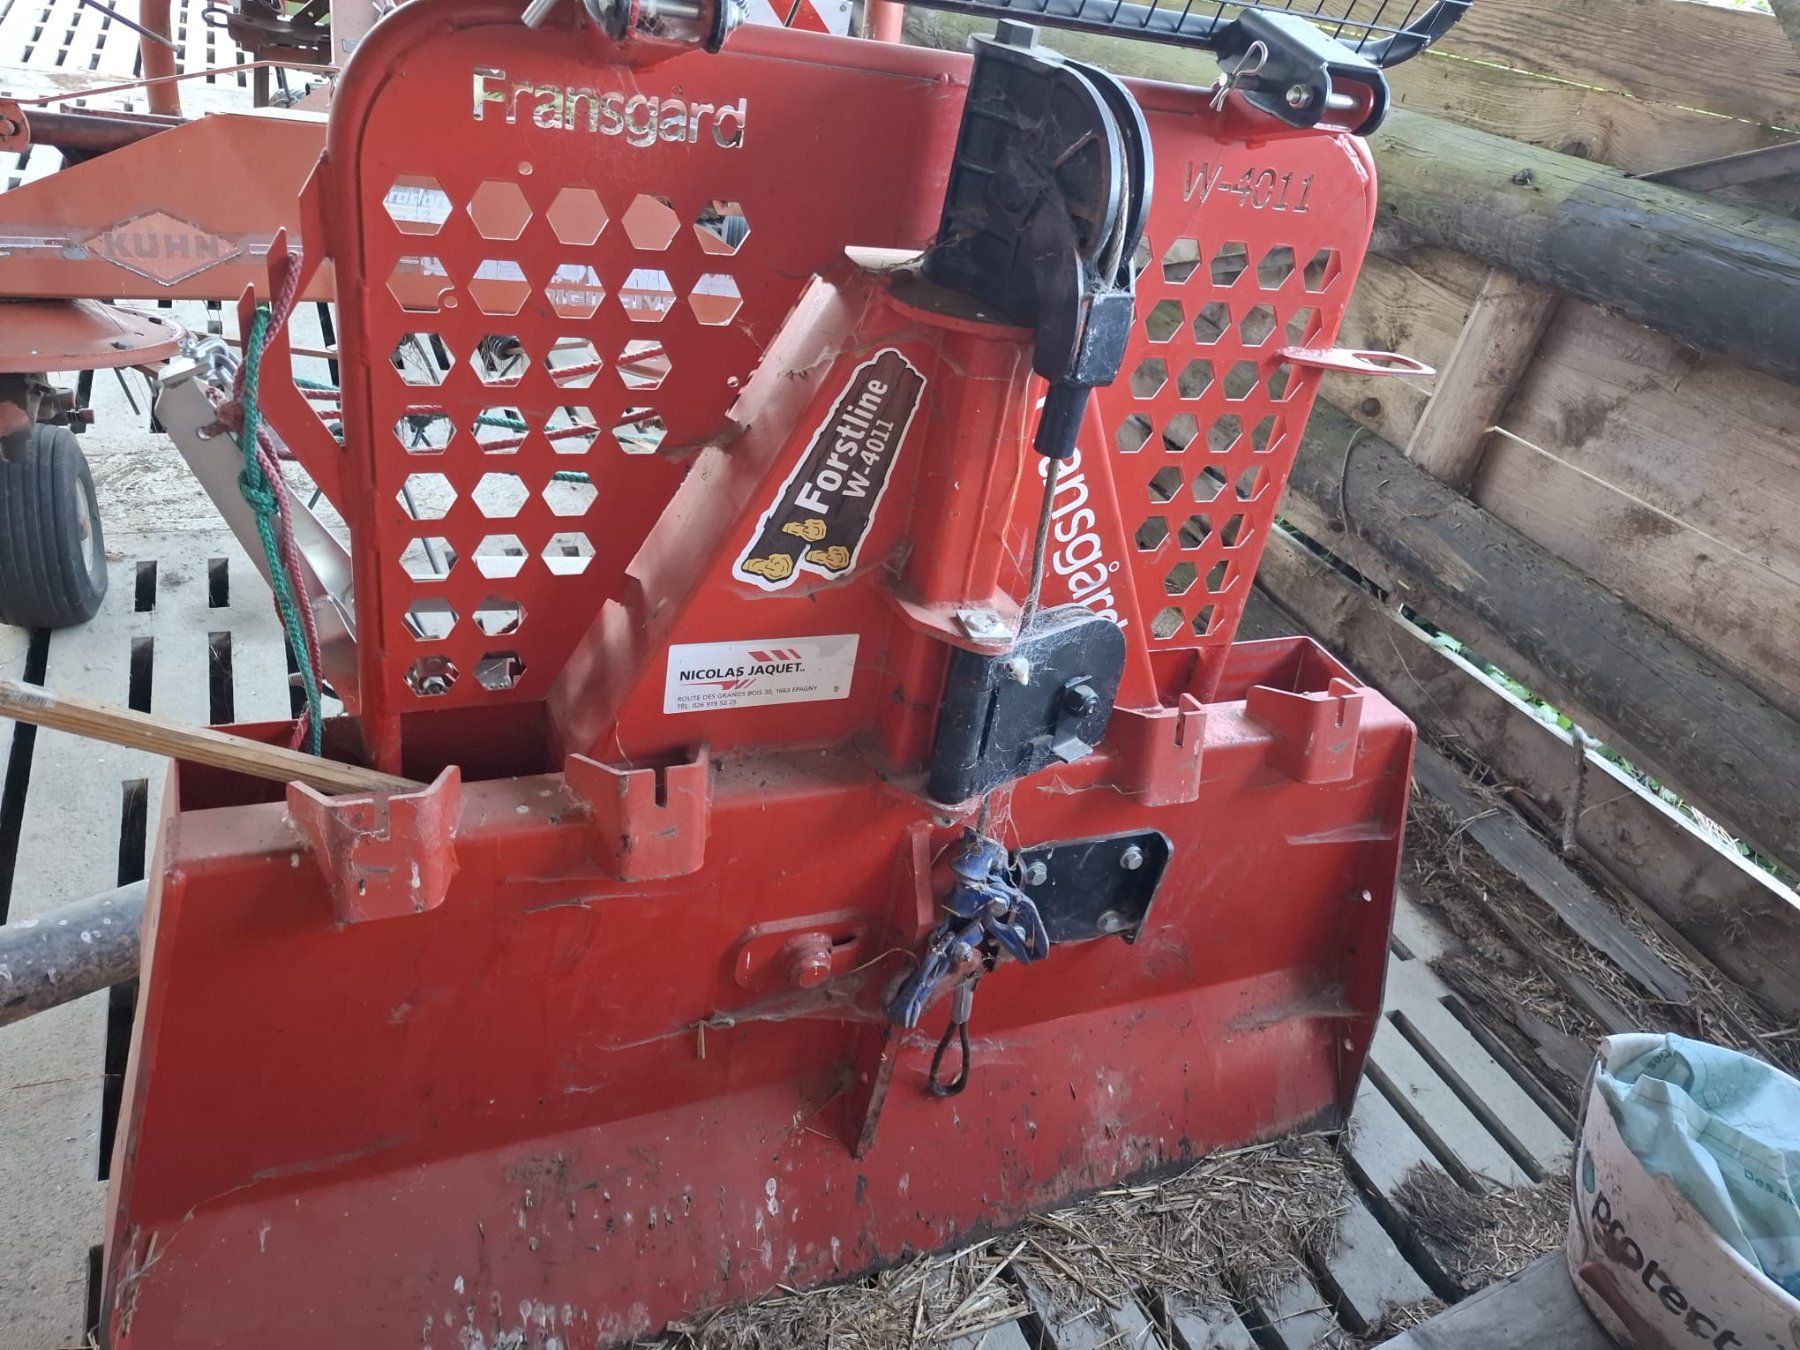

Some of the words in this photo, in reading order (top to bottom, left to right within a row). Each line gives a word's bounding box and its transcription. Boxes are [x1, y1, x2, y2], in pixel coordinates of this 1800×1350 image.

[1183, 160, 1315, 213] W-4011
[103, 232, 220, 259] KUHN
[794, 379, 888, 515] Forstline
[842, 419, 894, 498] W-4011
[679, 667, 744, 682] NICOLAS
[677, 694, 701, 703] ROUTE
[717, 691, 746, 699] GRANDS
